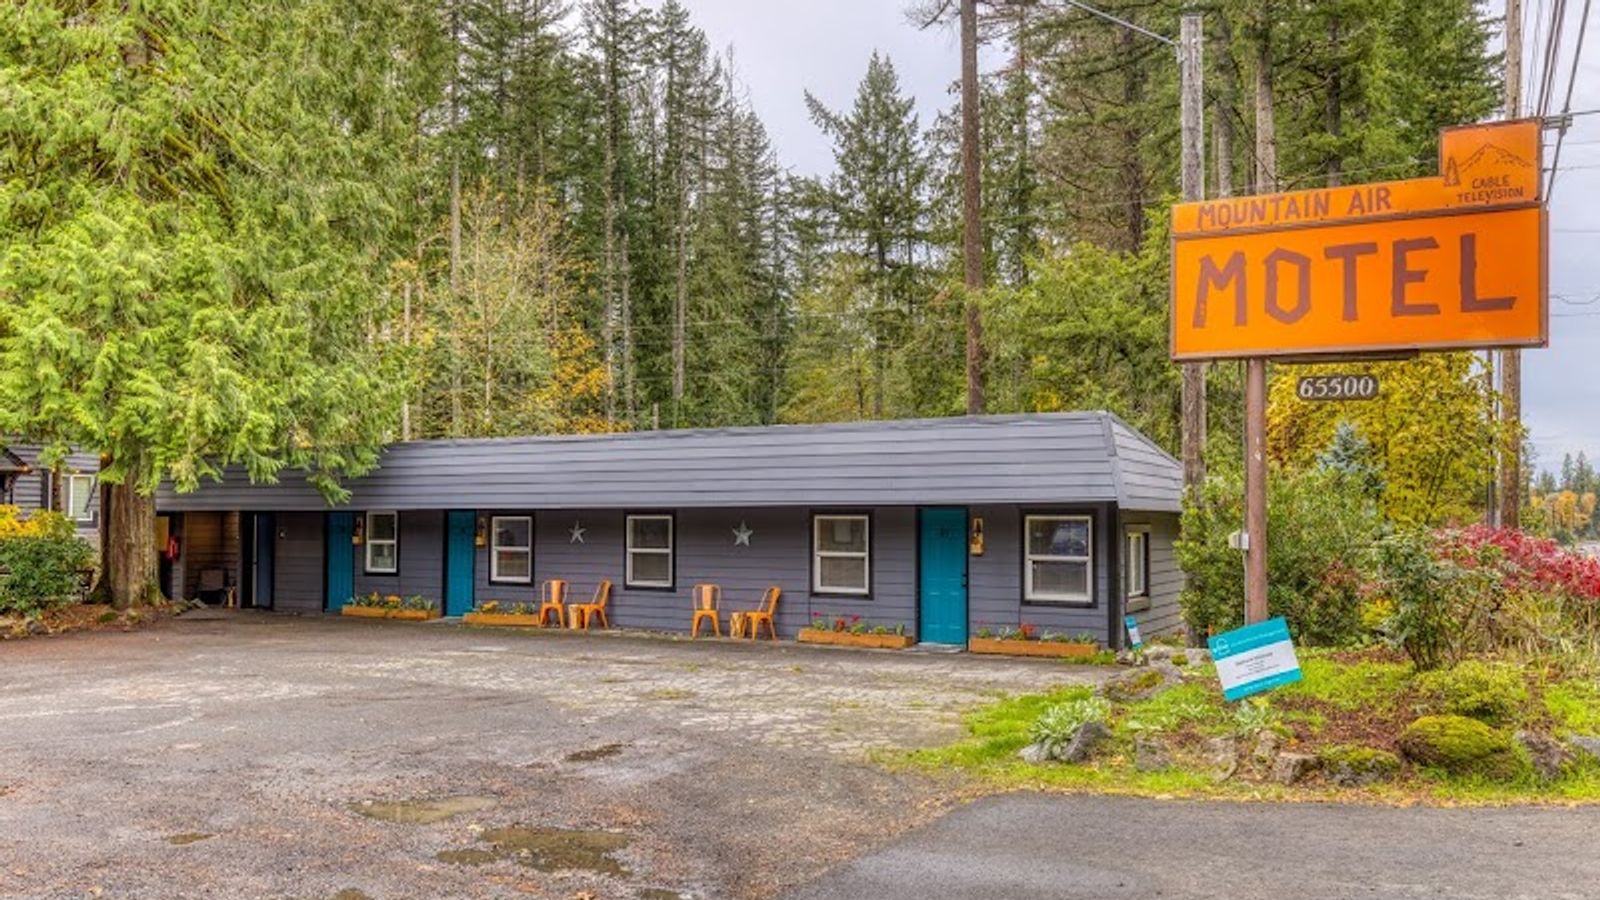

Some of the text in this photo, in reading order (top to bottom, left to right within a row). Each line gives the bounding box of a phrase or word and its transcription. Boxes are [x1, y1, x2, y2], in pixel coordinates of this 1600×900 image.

[1472, 174, 1510, 189] CABLE
[1456, 186, 1524, 203] TELEVISION
[1197, 186, 1391, 231] MOUNTAIN AIR
[1193, 233, 1517, 328] MOTEL
[1299, 375, 1375, 398] 65500
